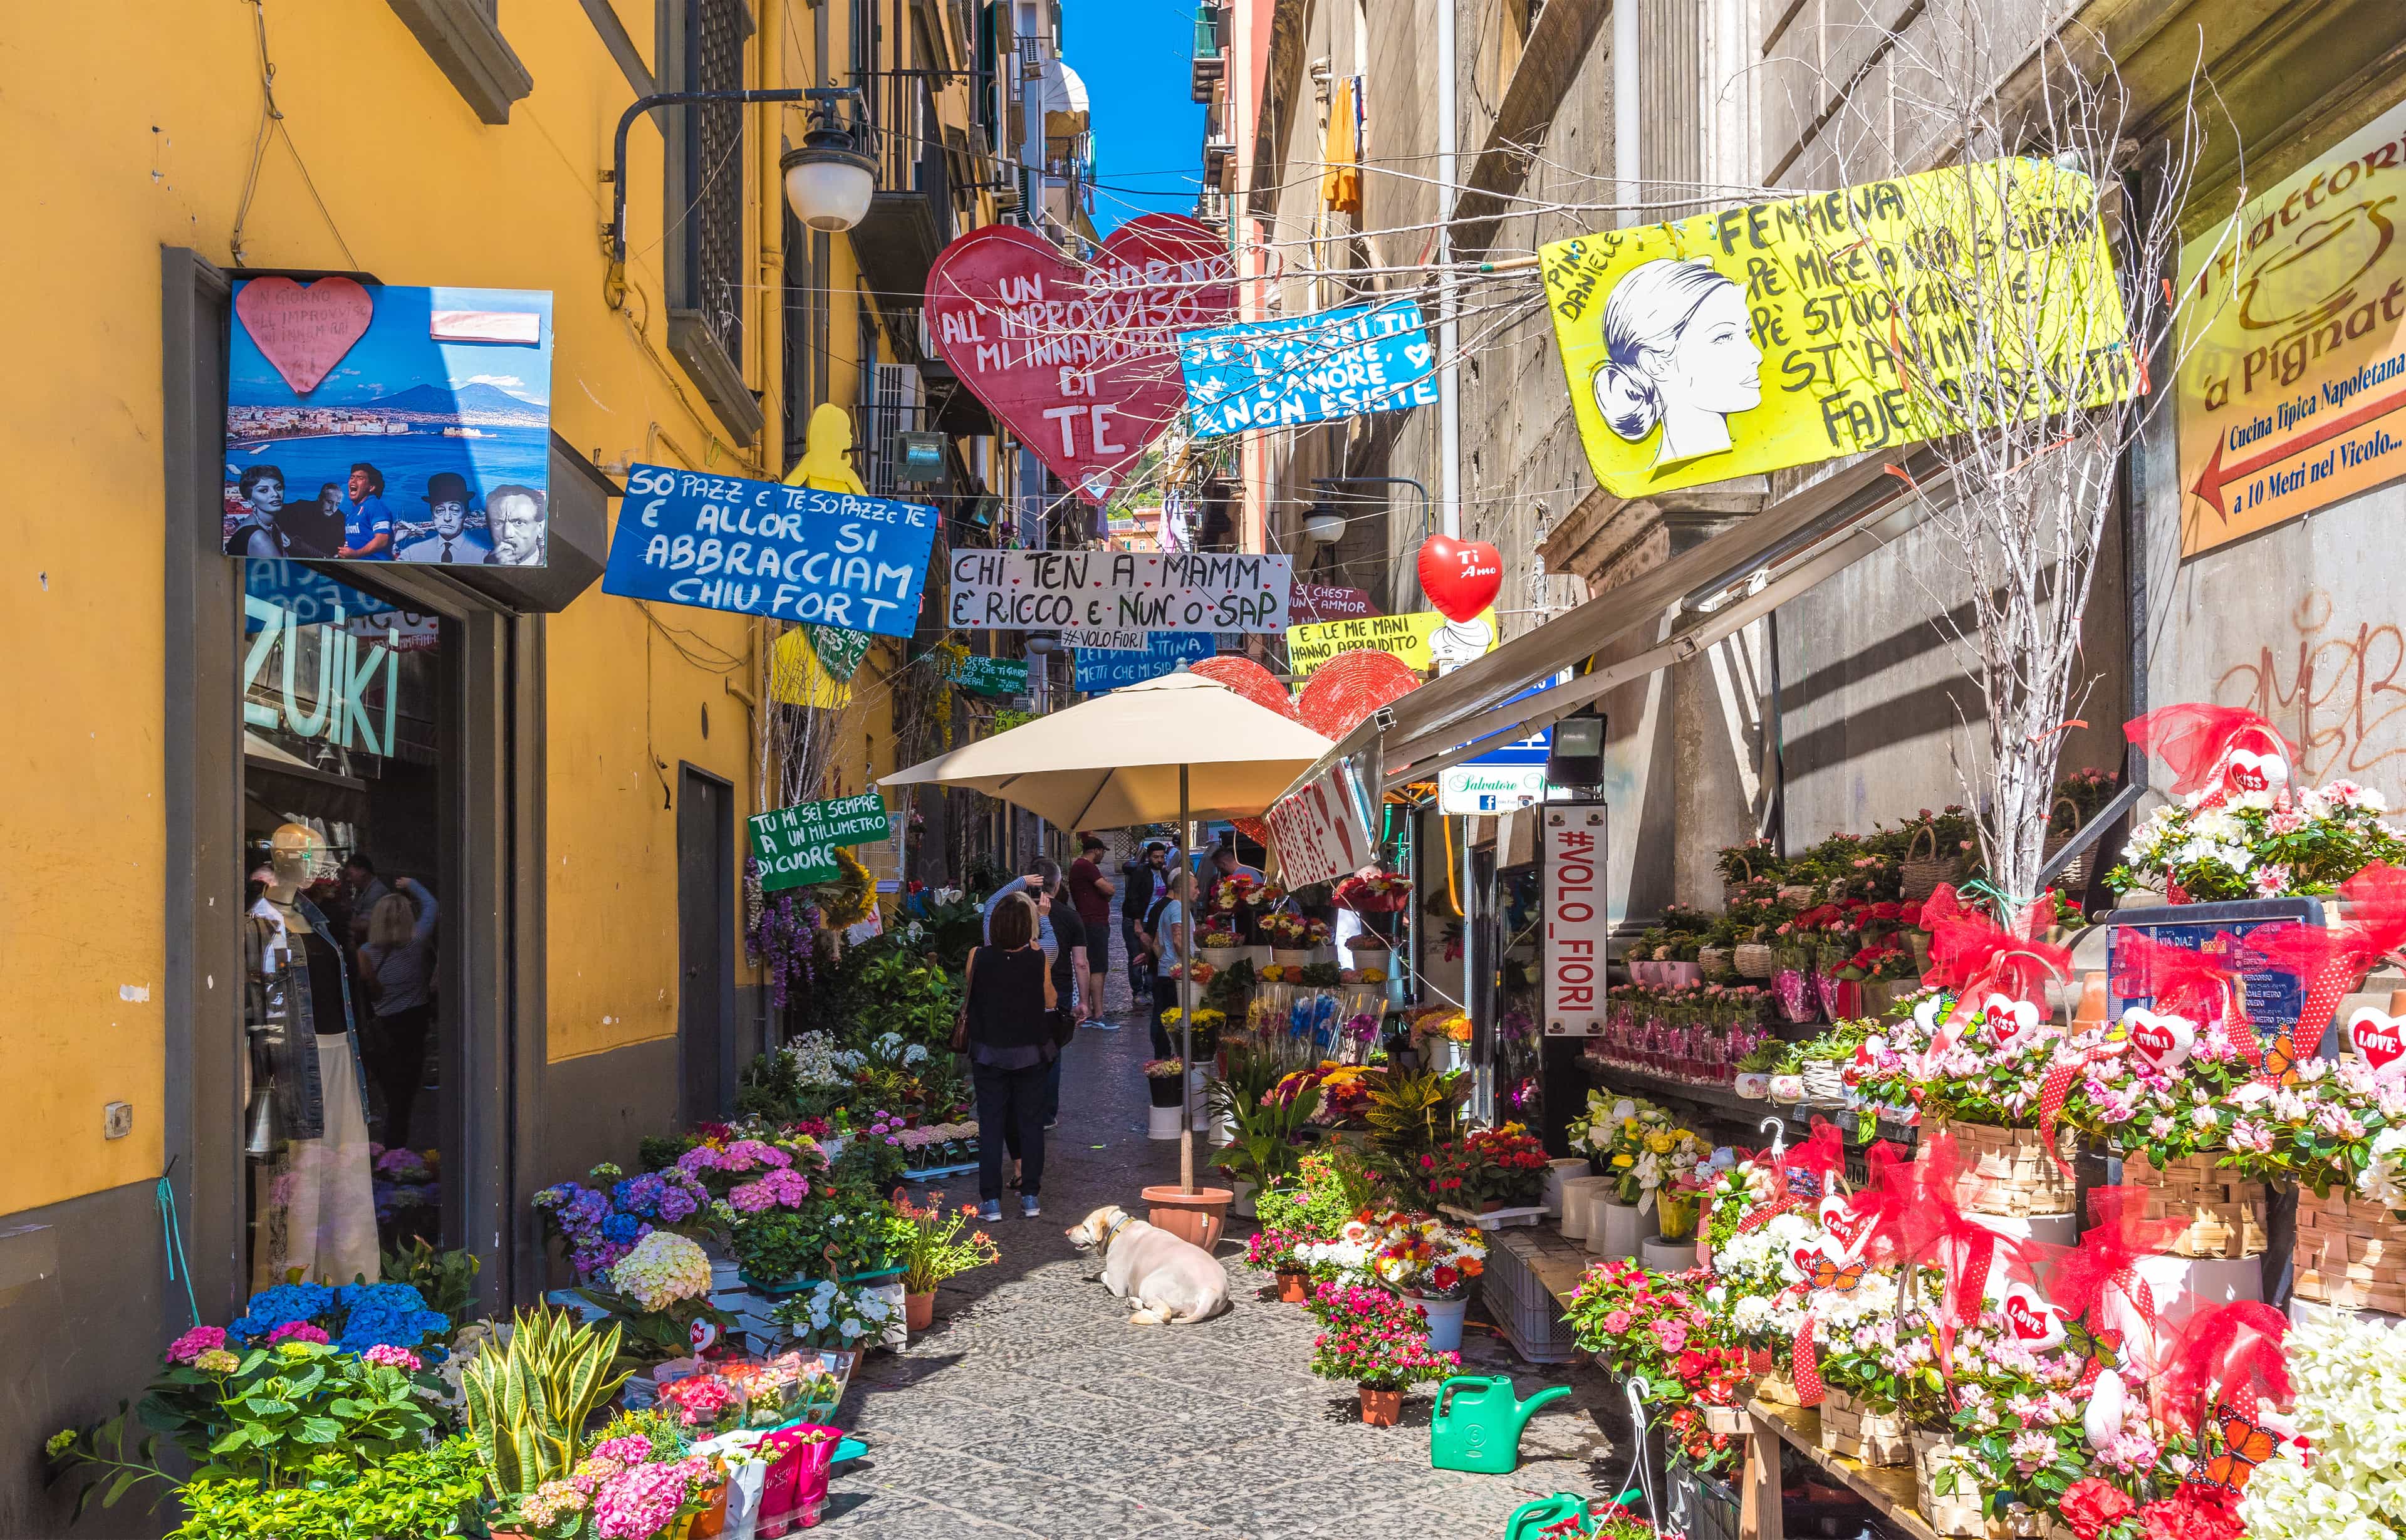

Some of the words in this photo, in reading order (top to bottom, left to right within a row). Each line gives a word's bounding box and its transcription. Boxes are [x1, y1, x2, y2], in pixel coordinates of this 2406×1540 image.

[999, 272, 1043, 305] UN
[1558, 233, 1623, 323] DANIELE
[1000, 289, 1199, 338] IMPROVVISO
[1378, 312, 1420, 337] TU
[976, 341, 1012, 373] MI
[1058, 365, 1096, 397] DI
[1223, 395, 1306, 428] NON
[1320, 380, 1439, 418] ESISTE
[2229, 415, 2272, 452] Cucina
[2276, 394, 2316, 433] Tipica
[2321, 352, 2405, 413] Napoletana
[1043, 403, 1126, 458] TE
[1818, 387, 1911, 450] FAJE
[2234, 494, 2242, 514] a
[2247, 479, 2264, 509] 10
[2267, 462, 2306, 502] Metri
[2310, 450, 2335, 484] nel
[2340, 429, 2403, 470] Vicolo...
[641, 499, 667, 528] E
[695, 504, 806, 543] ALLOR
[835, 523, 878, 554] SI
[902, 504, 926, 528] TE
[645, 534, 914, 600] ABBRACCIAM
[1024, 551, 1088, 590] TEN
[1112, 554, 1135, 588] A
[1457, 549, 1479, 564] Ti
[1461, 565, 1496, 578] Amo
[669, 578, 761, 611] CHIU
[772, 583, 899, 630] FORT
[1313, 587, 1353, 599] CHEST
[1321, 599, 1367, 613] AMMOR
[1118, 591, 1176, 628] NUN
[1214, 591, 1278, 627] SAP
[1299, 627, 1311, 642] E
[1323, 623, 1340, 640] LE
[1291, 643, 1331, 661] HANNO
[1006, 667, 1028, 677] GUARDA
[1113, 665, 1135, 679] CHE
[1138, 662, 1150, 678] MI
[1449, 772, 1518, 792] Salvatore
[751, 814, 777, 833] TU
[828, 794, 880, 818] SEMPRE
[759, 835, 778, 854] A
[788, 827, 805, 846] UN
[776, 843, 837, 873] CUORE
[2159, 937, 2174, 947] VIA
[2175, 936, 2193, 946] DIAZ
[2358, 1030, 2397, 1054] LOVE
[692, 1328, 702, 1339] LOVE
[2010, 1303, 2043, 1334] LOVE
